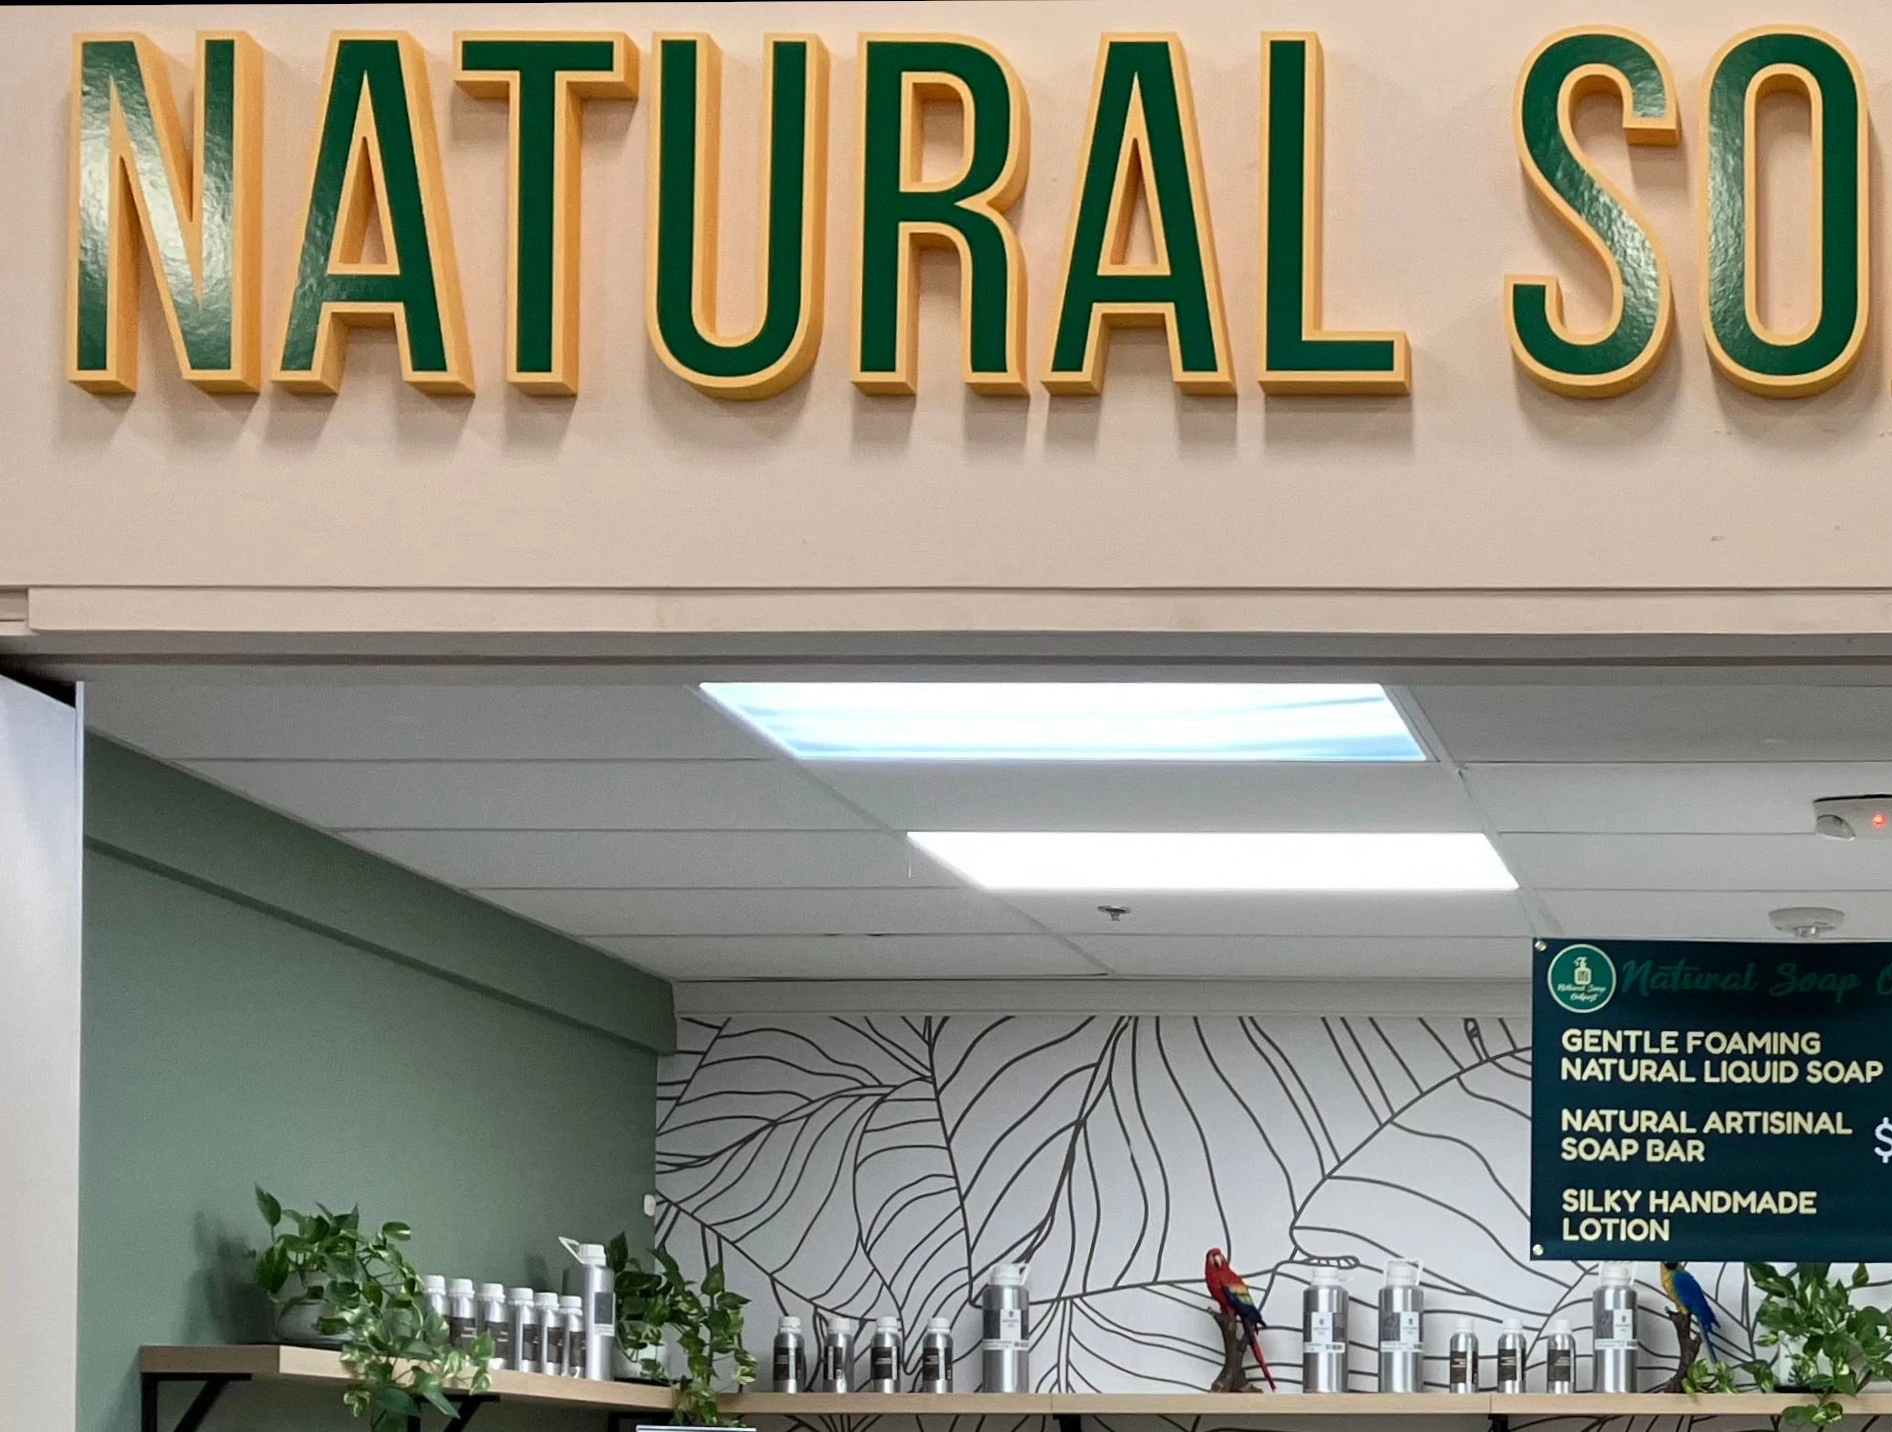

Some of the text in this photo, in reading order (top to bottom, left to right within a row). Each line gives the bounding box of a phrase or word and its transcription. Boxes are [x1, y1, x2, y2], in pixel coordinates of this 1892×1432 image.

[68, 30, 1411, 396] NATURAL
[1621, 957, 1757, 996] Natural
[1770, 961, 1861, 1002] Soap
[1561, 1028, 1821, 1056] GENTLE FOAMING
[1561, 1057, 1884, 1084] NATURAL LIQUID SOAP
[1561, 1108, 1853, 1135] NATURAL ARTISINAL
[1560, 1137, 1706, 1163] SOAP BAR
[1562, 1188, 1818, 1215] SILKY HANDMADE
[1562, 1217, 1670, 1242] LOTION
